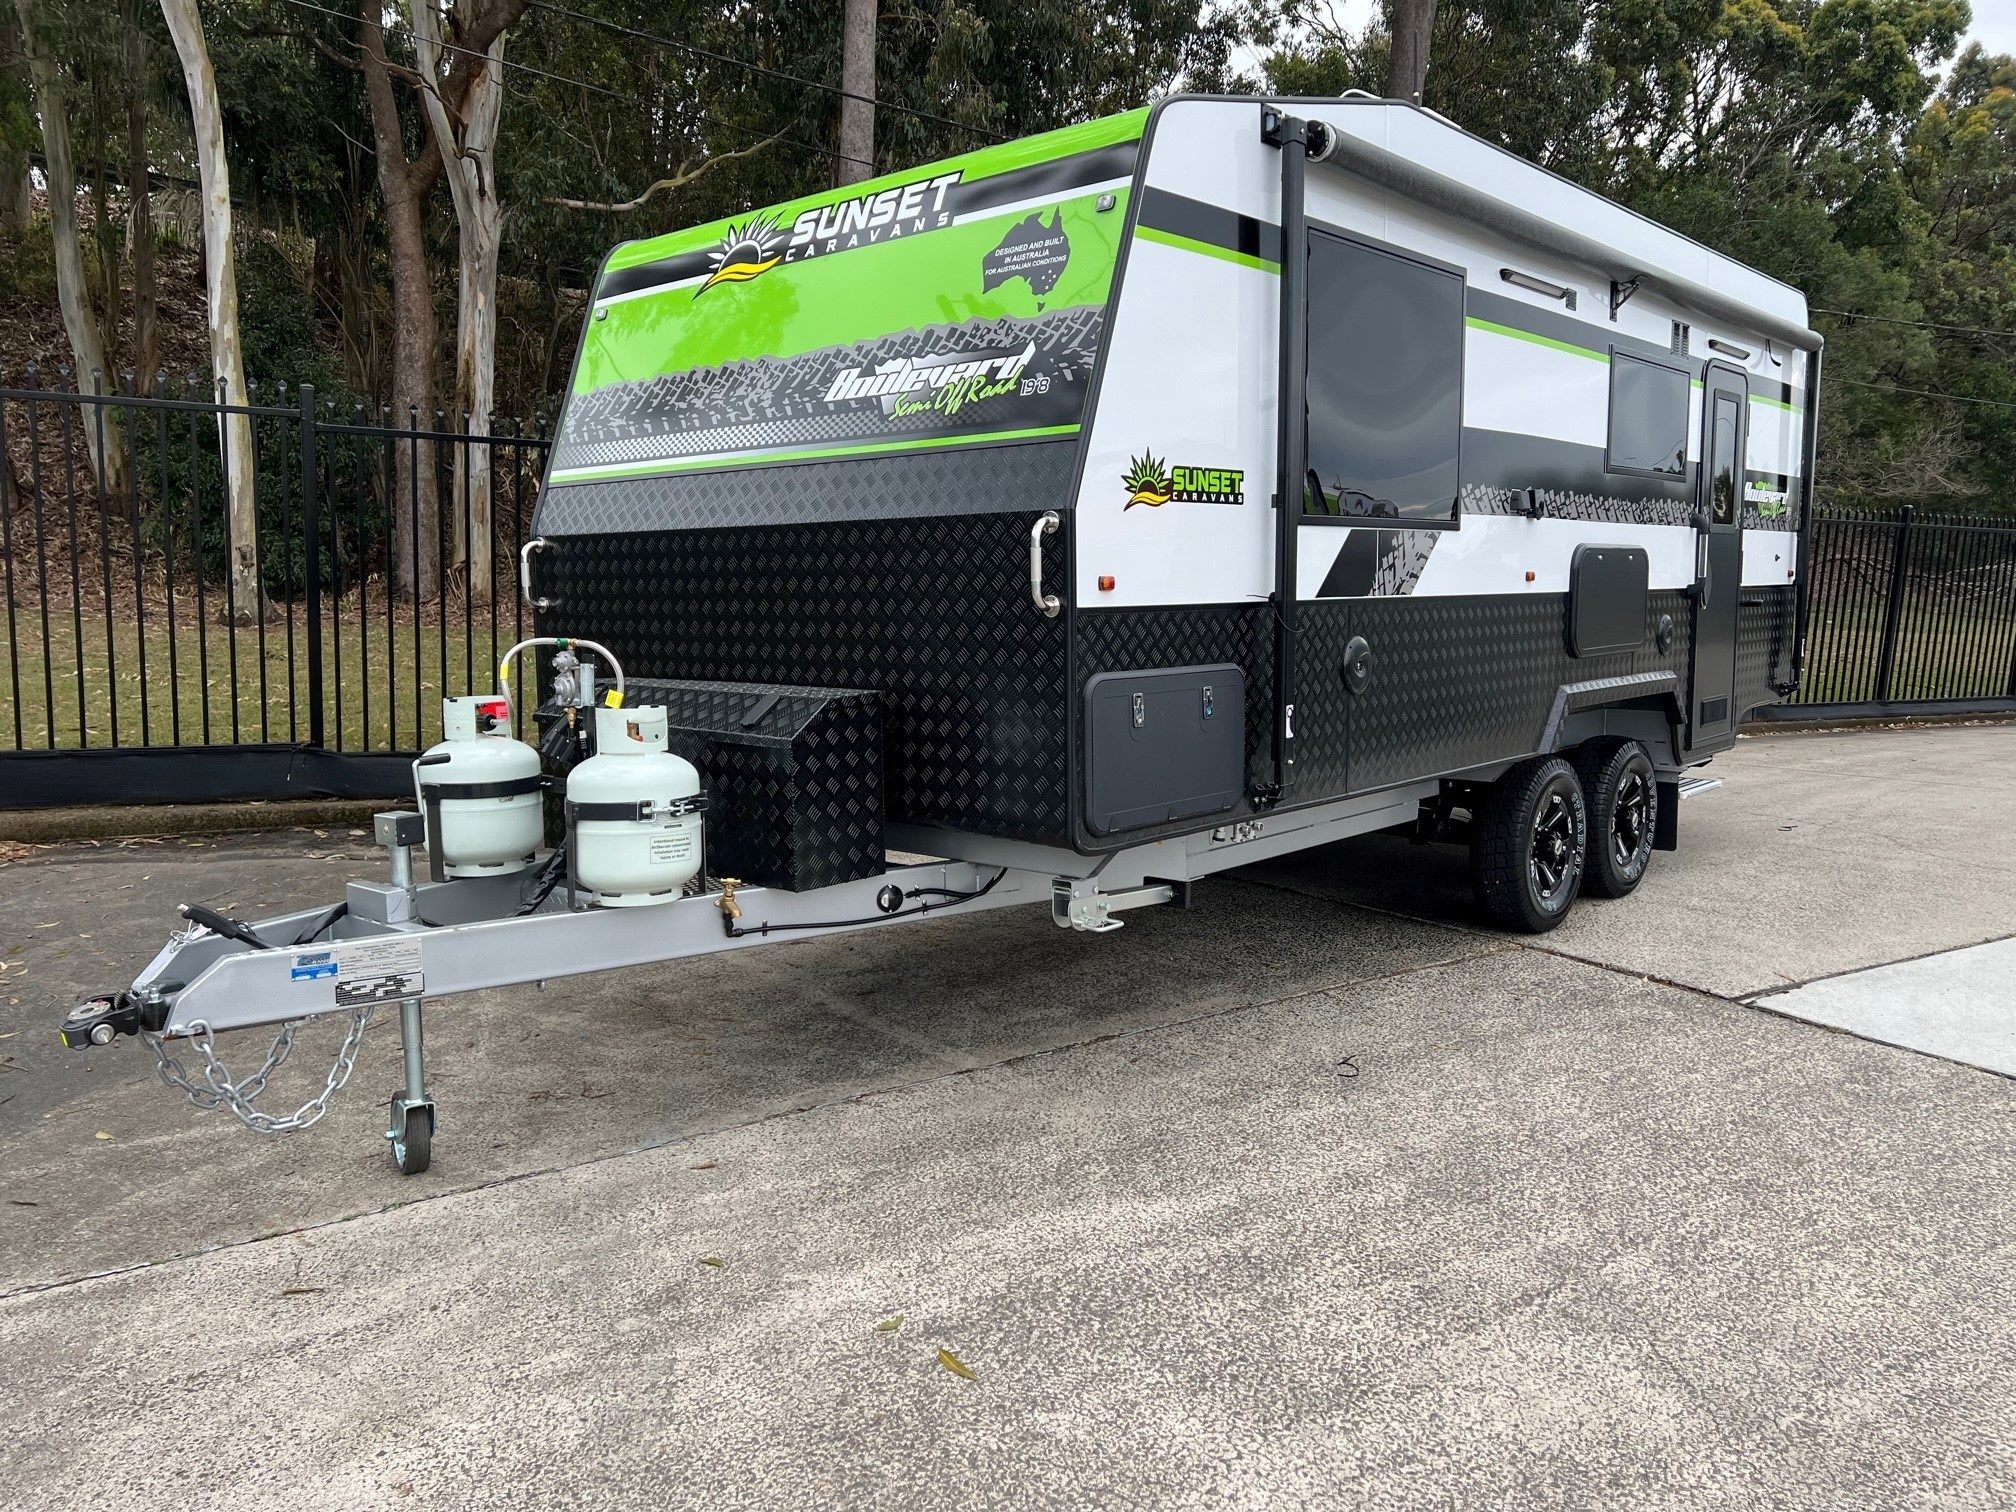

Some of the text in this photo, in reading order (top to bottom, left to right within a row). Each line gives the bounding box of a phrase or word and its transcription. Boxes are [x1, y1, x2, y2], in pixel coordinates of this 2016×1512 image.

[787, 171, 963, 247] SUNSET
[784, 211, 949, 263] CARAVANS
[994, 236, 1065, 257] DESIGNED AND BUILT
[984, 254, 1067, 276] FOR AUSTRALIAN CONDITIONS
[1004, 248, 1050, 264] IN AUSTRALIA
[823, 340, 1036, 402] Boulevard
[888, 365, 1025, 421] Semi Off Road
[1171, 467, 1243, 494] SUNSET
[1172, 491, 1243, 503] CARAVANS
